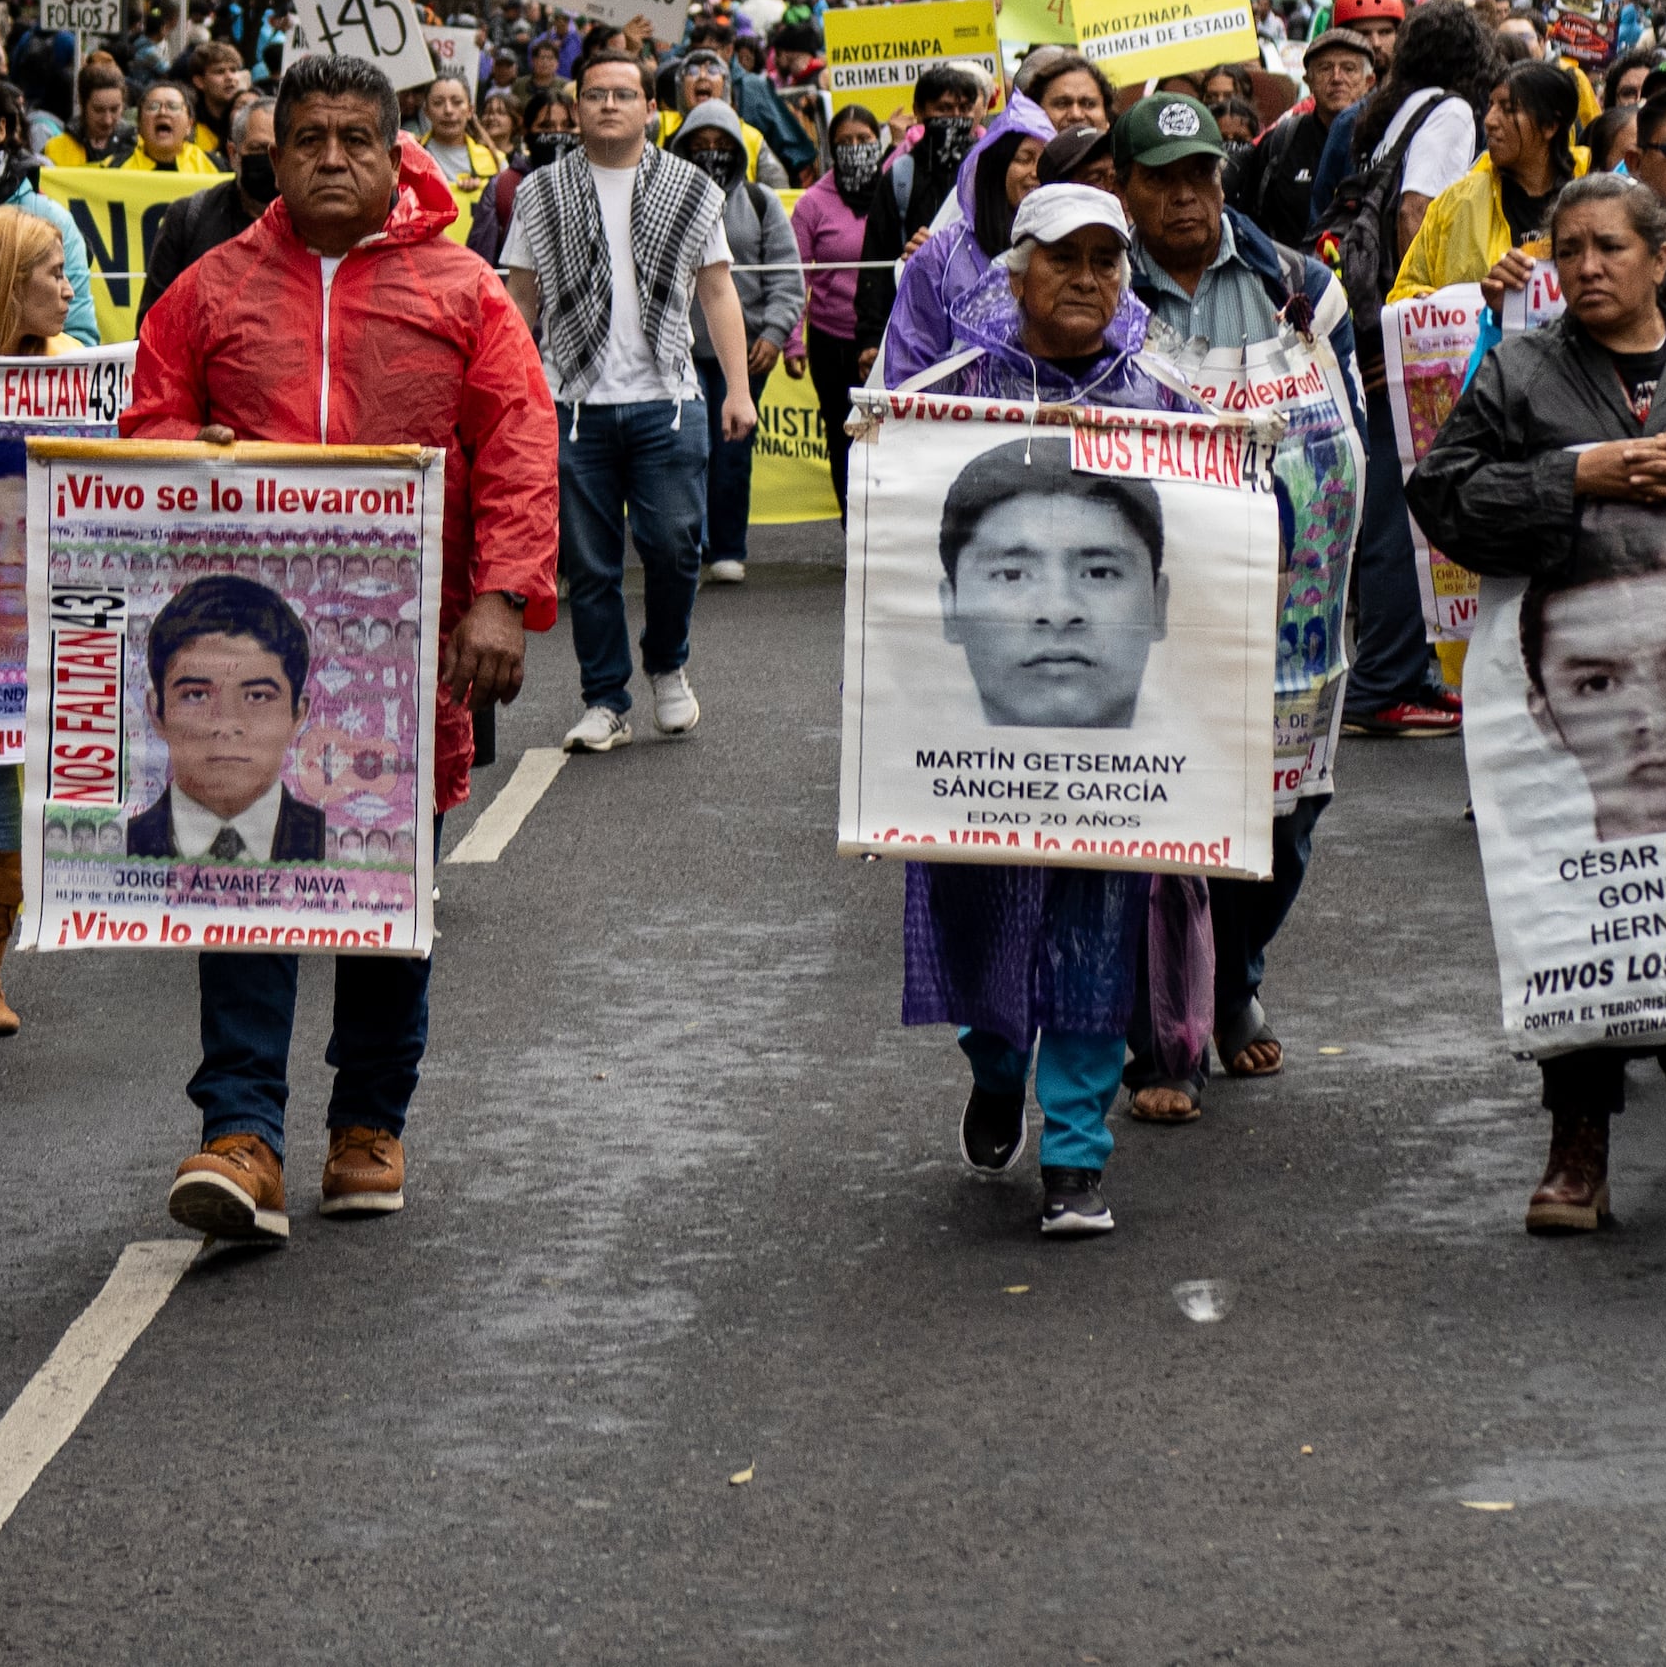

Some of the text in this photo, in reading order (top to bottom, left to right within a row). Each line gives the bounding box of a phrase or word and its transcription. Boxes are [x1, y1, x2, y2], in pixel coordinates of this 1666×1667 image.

[1082, 3, 1193, 39] #AYOTZINAPA
[1085, 12, 1246, 59] CRIMEN DE ESTADO
[832, 38, 943, 63] #AYOTZINAPA
[834, 66, 899, 87] CRIMEN
[1404, 305, 1466, 336] ¡Vivo
[4, 368, 89, 417] FALTAN
[88, 362, 125, 421] 43!
[1074, 424, 1132, 470] NOS
[1141, 428, 1242, 488] FALTAN
[56, 474, 415, 517] ¡Vivo se lo llevaron!
[51, 585, 125, 803] NOS FALTAN 43!
[916, 748, 1188, 775] MARTÍN GETSEMANY
[932, 775, 1169, 804] SÁNCHEZ GARCÍA
[967, 809, 1142, 829] EDAD 20 AÑOS
[1559, 845, 1659, 882] CÉSAR
[115, 867, 346, 895] JORGE ÁLVAREZ NAVA
[58, 911, 147, 945] ¡Vivo
[160, 914, 191, 944] lo
[1524, 959, 1615, 1004] ¡VIVOS
[1524, 1010, 1575, 1031] CONTRA
[1580, 1007, 1595, 1020] EL
